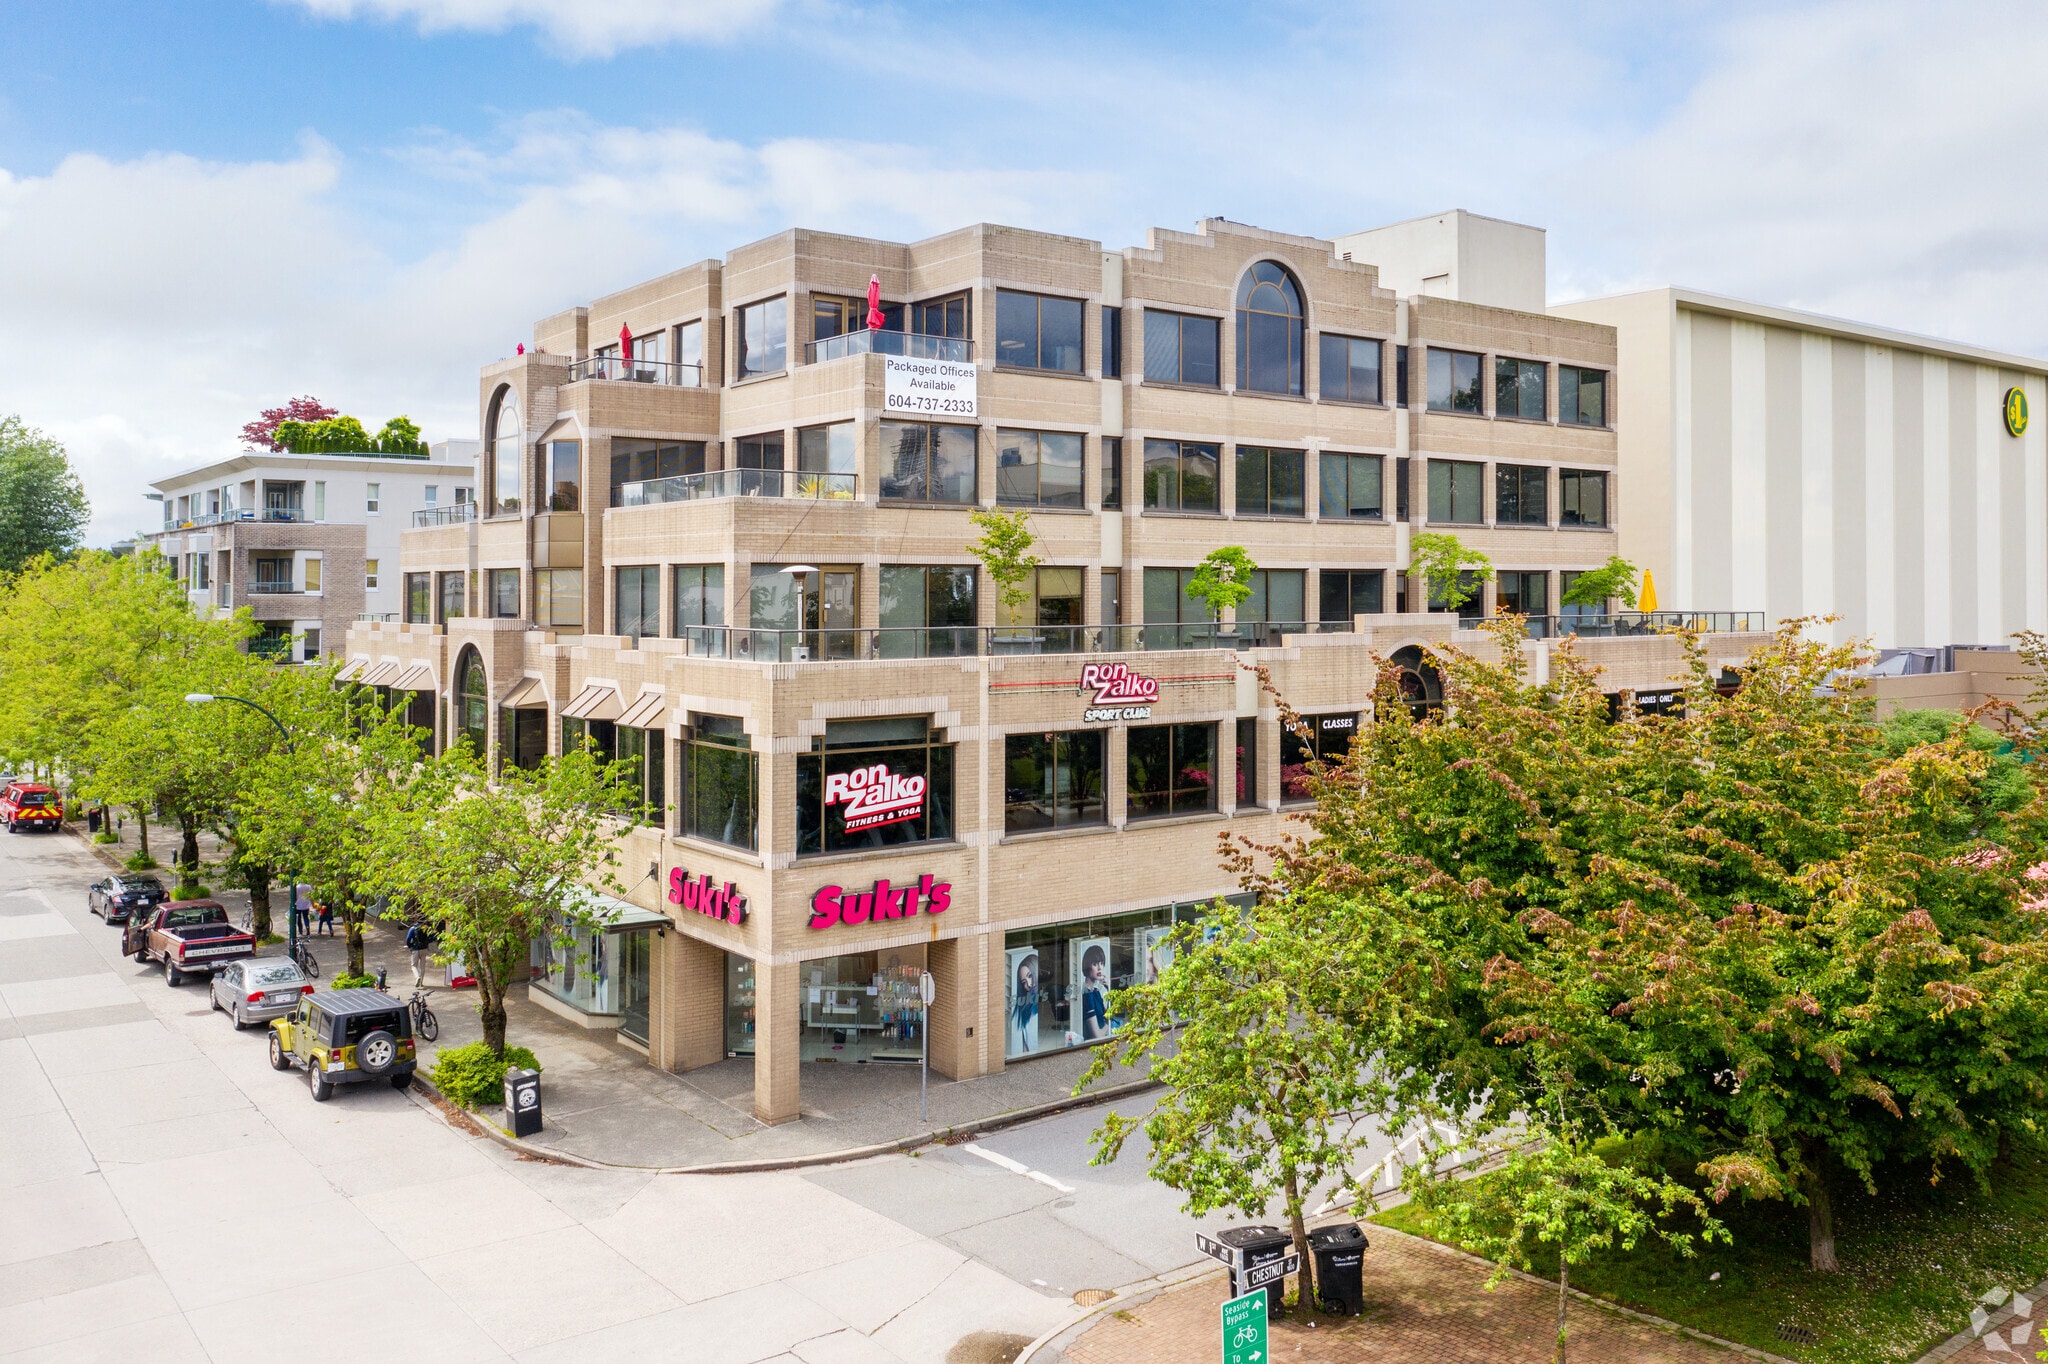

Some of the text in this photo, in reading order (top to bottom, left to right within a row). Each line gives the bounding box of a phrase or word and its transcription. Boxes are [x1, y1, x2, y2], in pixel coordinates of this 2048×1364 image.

[888, 360, 975, 377] Packaged Offices
[910, 377, 956, 391] Available
[888, 394, 974, 413] 604-737-2333
[1082, 663, 1128, 690] Ron
[1093, 674, 1159, 704] Zalko
[1638, 694, 1674, 704] LADIES ONLY
[1085, 707, 1151, 721] SPORT CLUB
[1284, 718, 1353, 732] YOA CLASSES
[824, 764, 888, 805] Ron
[844, 773, 926, 820] Zalko
[846, 815, 884, 829] FITNESS
[898, 806, 921, 817] YOGA
[668, 866, 747, 926] Suki's
[808, 873, 953, 930] Suki's
[191, 945, 246, 957] CHEVROLET
[1199, 1236, 1206, 1251] W
[1251, 1262, 1284, 1284] CHESTNUT
[1225, 1300, 1250, 1316] Seaside
[1226, 1311, 1249, 1326] Bypass
